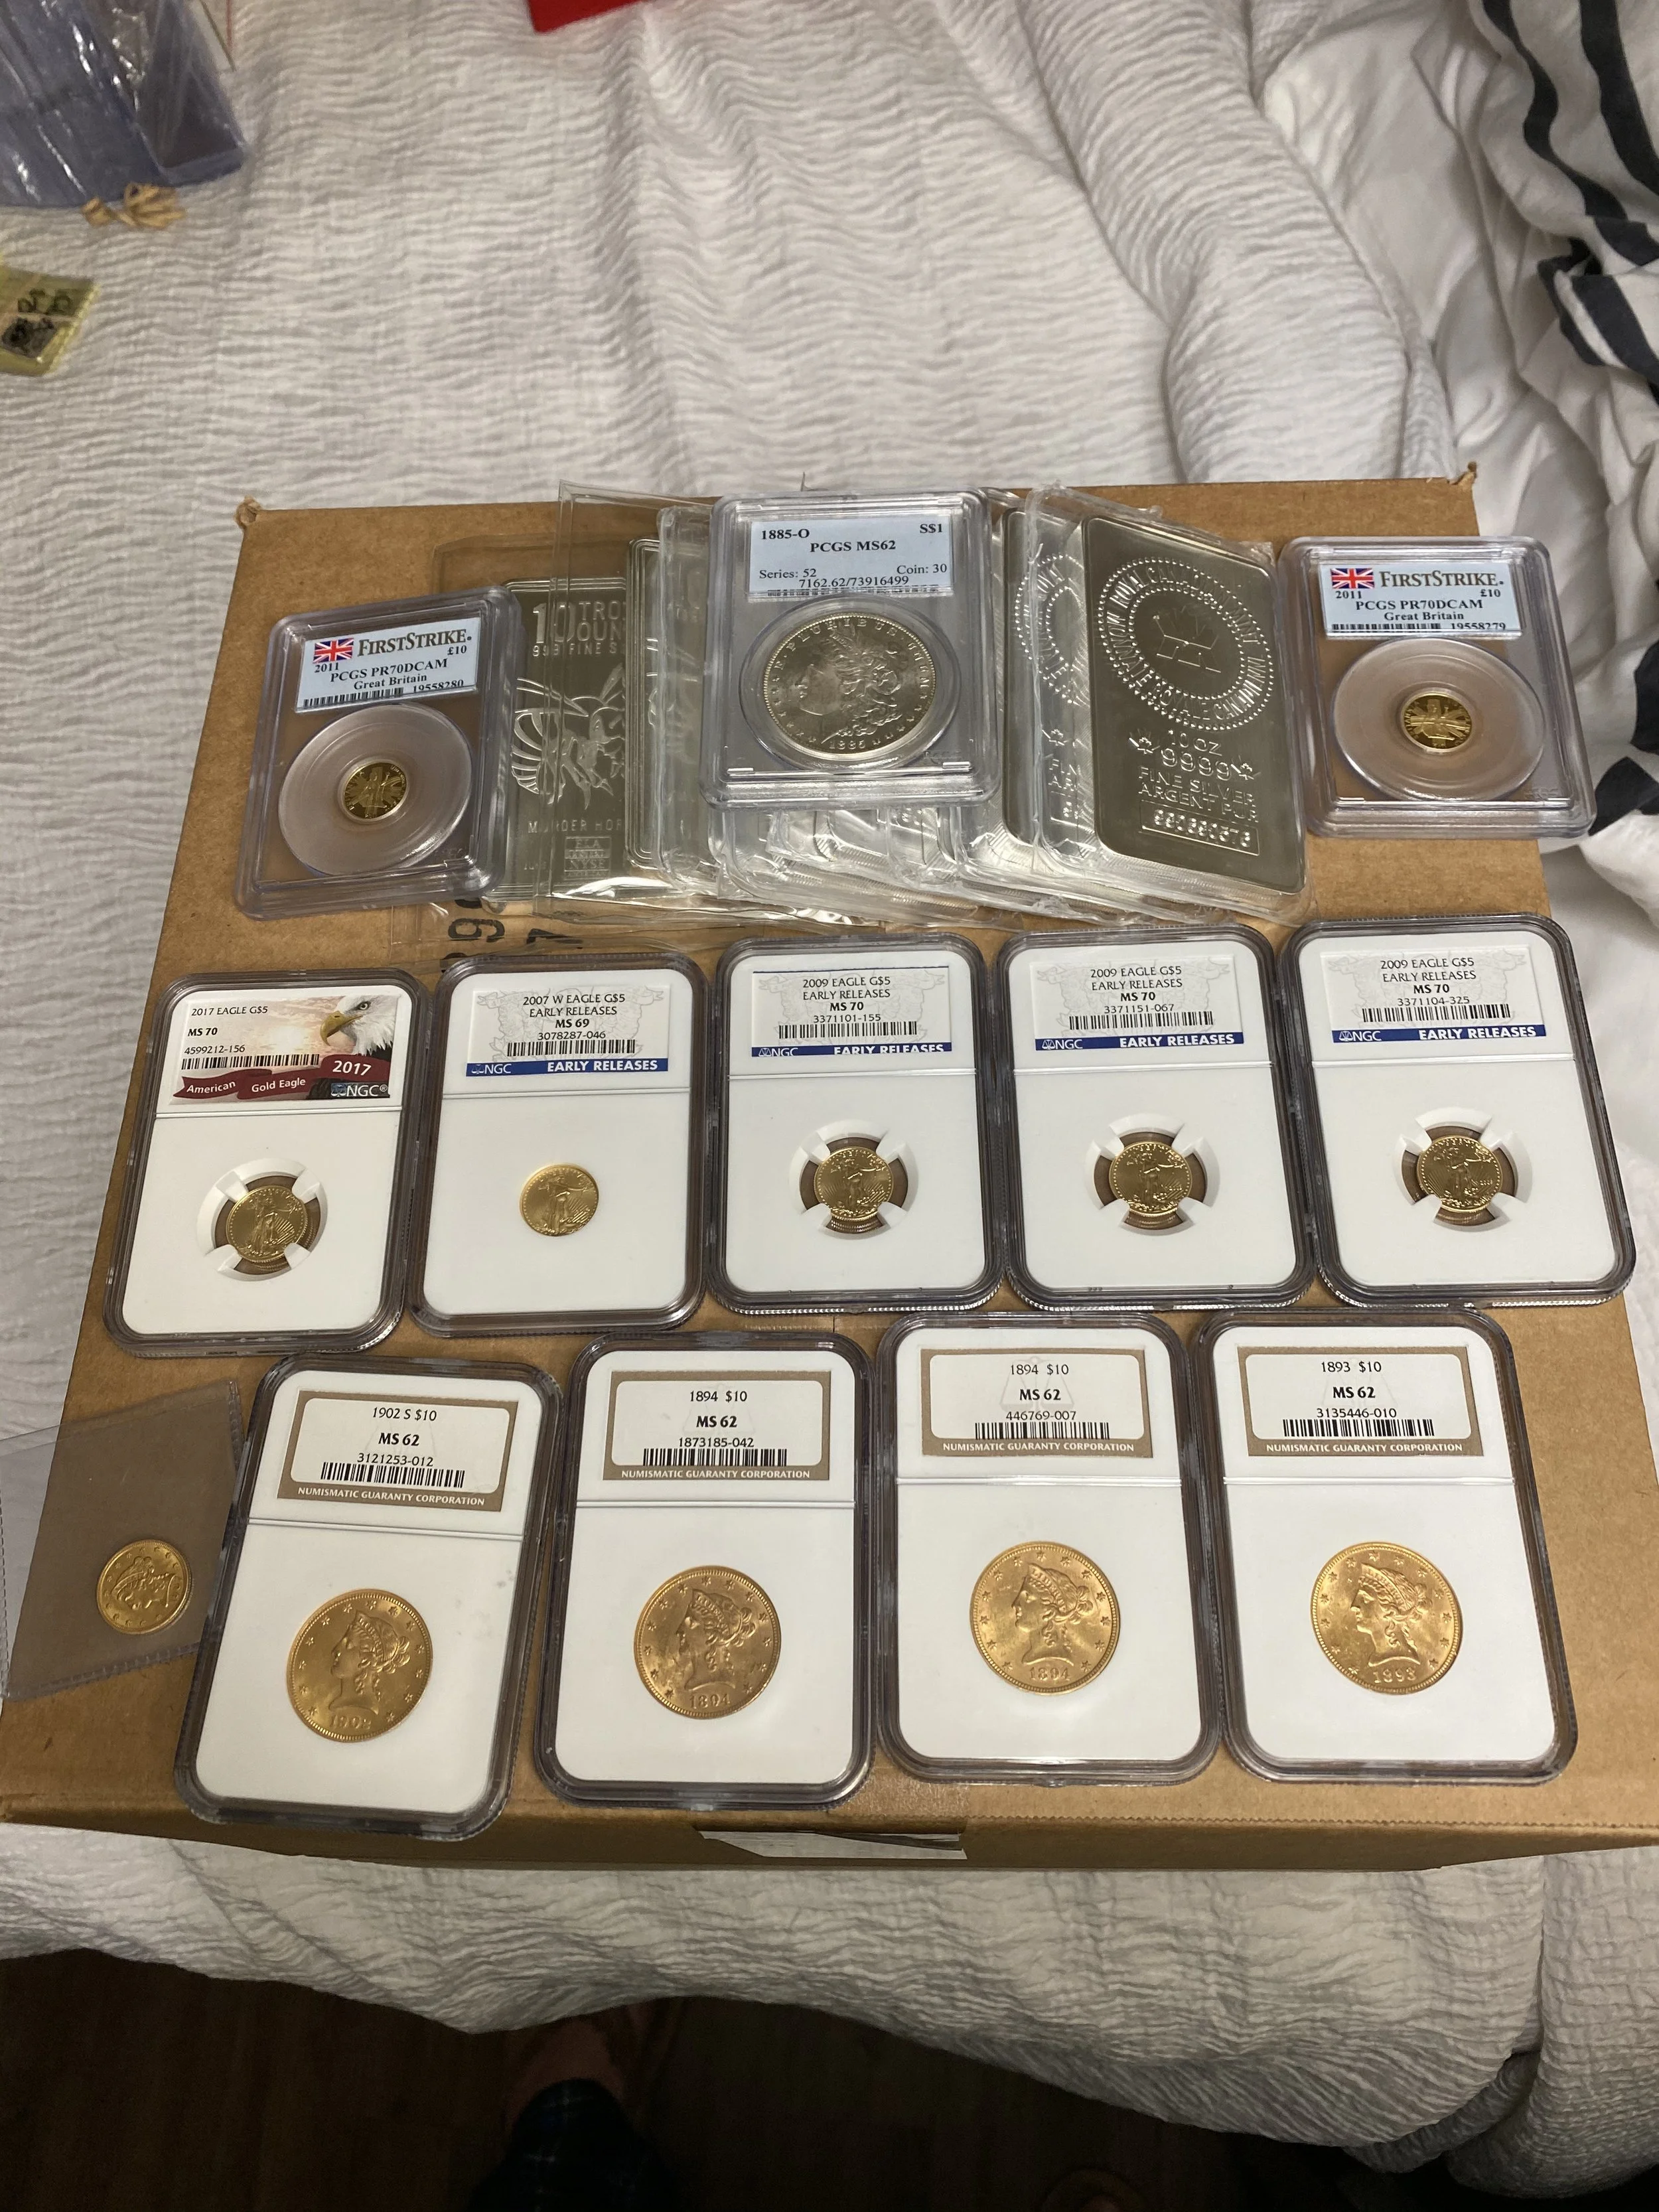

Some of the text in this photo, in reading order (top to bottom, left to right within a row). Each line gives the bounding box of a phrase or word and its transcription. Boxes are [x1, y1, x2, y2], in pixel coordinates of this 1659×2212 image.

[761, 523, 942, 540] 1885-O S$1
[810, 540, 897, 553] PCGS MS62
[759, 563, 948, 579] Series: 52 Coin: 30
[798, 575, 909, 589] 7162.62/73916499
[1335, 589, 1501, 599] 2011 £10
[579, 601, 626, 621] TRO
[1356, 599, 1483, 611] PCGS PR70DCAM
[1384, 611, 1464, 621] Great Britain
[533, 601, 577, 644] 10
[1451, 622, 1506, 630] 19558279
[447, 645, 467, 656] £10
[314, 662, 339, 673] 2011
[330, 658, 448, 682] PCGS PR70DCAM
[354, 674, 427, 690] Great Britain
[412, 679, 464, 693] 19558280
[1168, 729, 1189, 749] 10
[1161, 747, 1232, 781] 9999
[1139, 767, 1183, 789] FINE
[1138, 782, 1216, 811] ARGENT
[1380, 957, 1475, 969] 2009 EAGLE G$5
[1090, 966, 1182, 978] 2009 EAGLE G$5
[1383, 971, 1477, 982] EARLY RELEASES
[803, 976, 891, 988] 2009 EAGLE G$5
[1092, 979, 1183, 990] EARLY RELEASES
[803, 989, 891, 1000] EARLY RELEASES
[1413, 984, 1449, 994] MS 70
[523, 994, 625, 1005] 2007 W EAGLE G$5
[1120, 993, 1138, 1001] MS
[1398, 996, 1470, 1006] 3371104-325
[192, 1005, 268, 1016] 2017 EAGLE G$5
[530, 1006, 617, 1017] EARLY RELEASES
[830, 1003, 847, 1011] MS
[1104, 1004, 1175, 1013] 3371151-067
[555, 1019, 589, 1028] MS 69
[814, 1014, 881, 1023] 3371101-155
[187, 1028, 203, 1037] MS
[538, 1031, 606, 1040] 3078287-046
[1352, 1027, 1536, 1041] NGC EARLY RELEASES
[1055, 1034, 1234, 1049] NGC EARLY RELEASES
[184, 1045, 246, 1055] 4599212-156
[772, 1044, 944, 1057] NGC EARLY RELEASES
[332, 1060, 372, 1076] 2017
[484, 1061, 658, 1074] NGC EARLY RELEASES
[186, 1077, 306, 1094] American Gold Eagle
[1011, 1363, 1069, 1376] 1894 $10
[1321, 1361, 1382, 1373] 1893 $10
[690, 1390, 747, 1403] 1894 $10
[1019, 1389, 1061, 1400] MS 62
[1333, 1387, 1376, 1398] MS 62
[372, 1407, 437, 1422] 1902 S $10
[1005, 1411, 1076, 1420] 446769-007
[1316, 1408, 1397, 1418] 3135446-010
[696, 1416, 737, 1428] MS 62
[378, 1433, 419, 1446] MS 62
[678, 1438, 755, 1447] 1873185-042
[943, 1442, 1134, 1451] NUMISMATIC GUARANTY CORPORATION
[1266, 1443, 1463, 1453] NUMISMATIC GUARANTY CORPORATION
[357, 1453, 433, 1467] 3121253-012
[621, 1469, 810, 1479] NUMISMATIC GUARANTY CORPORATION
[298, 1487, 485, 1507] NUMISMATIC GUARANTY CORPORATION
